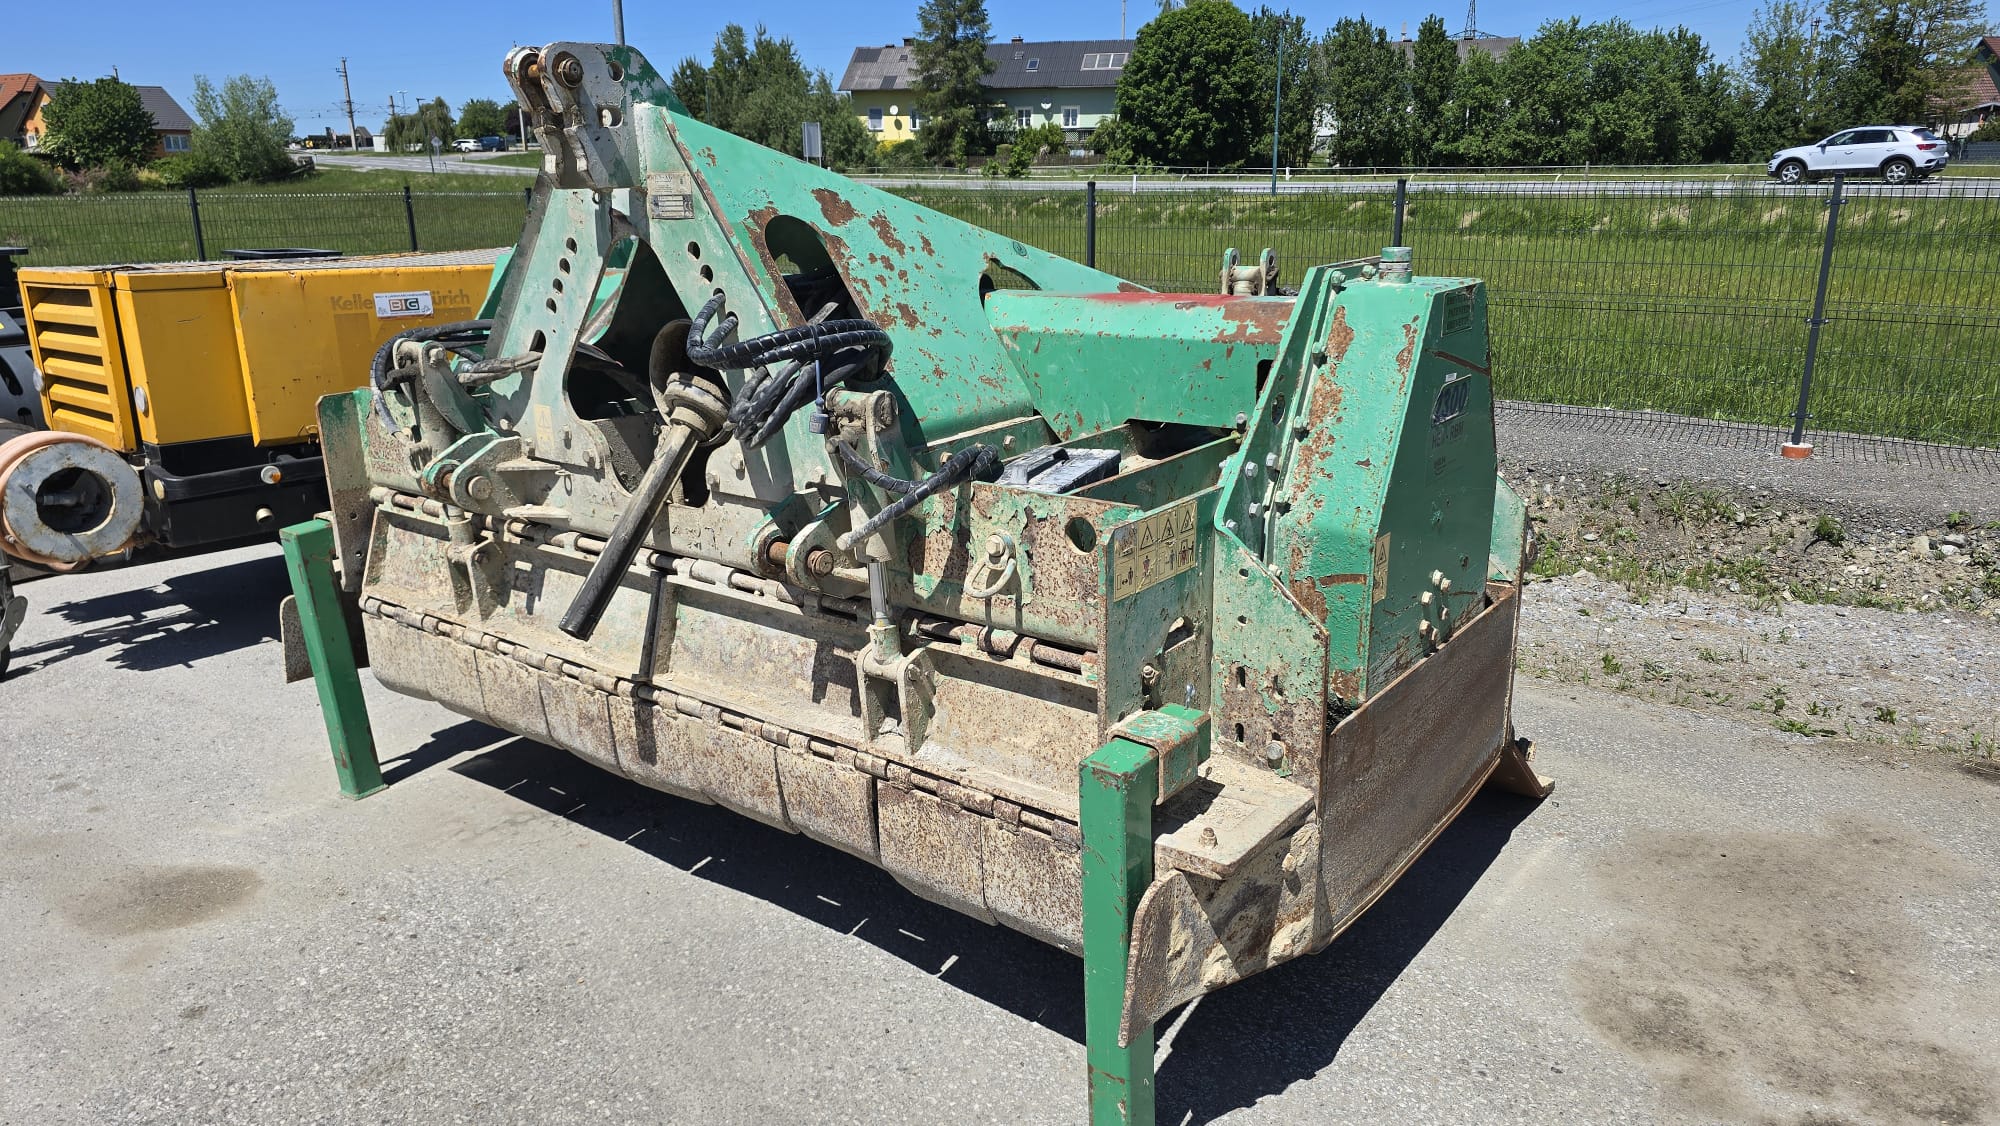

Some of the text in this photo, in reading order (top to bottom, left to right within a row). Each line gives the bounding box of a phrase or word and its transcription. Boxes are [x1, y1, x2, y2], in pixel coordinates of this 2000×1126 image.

[330, 289, 471, 311] Kelle ürich
[389, 298, 420, 311] BIG
